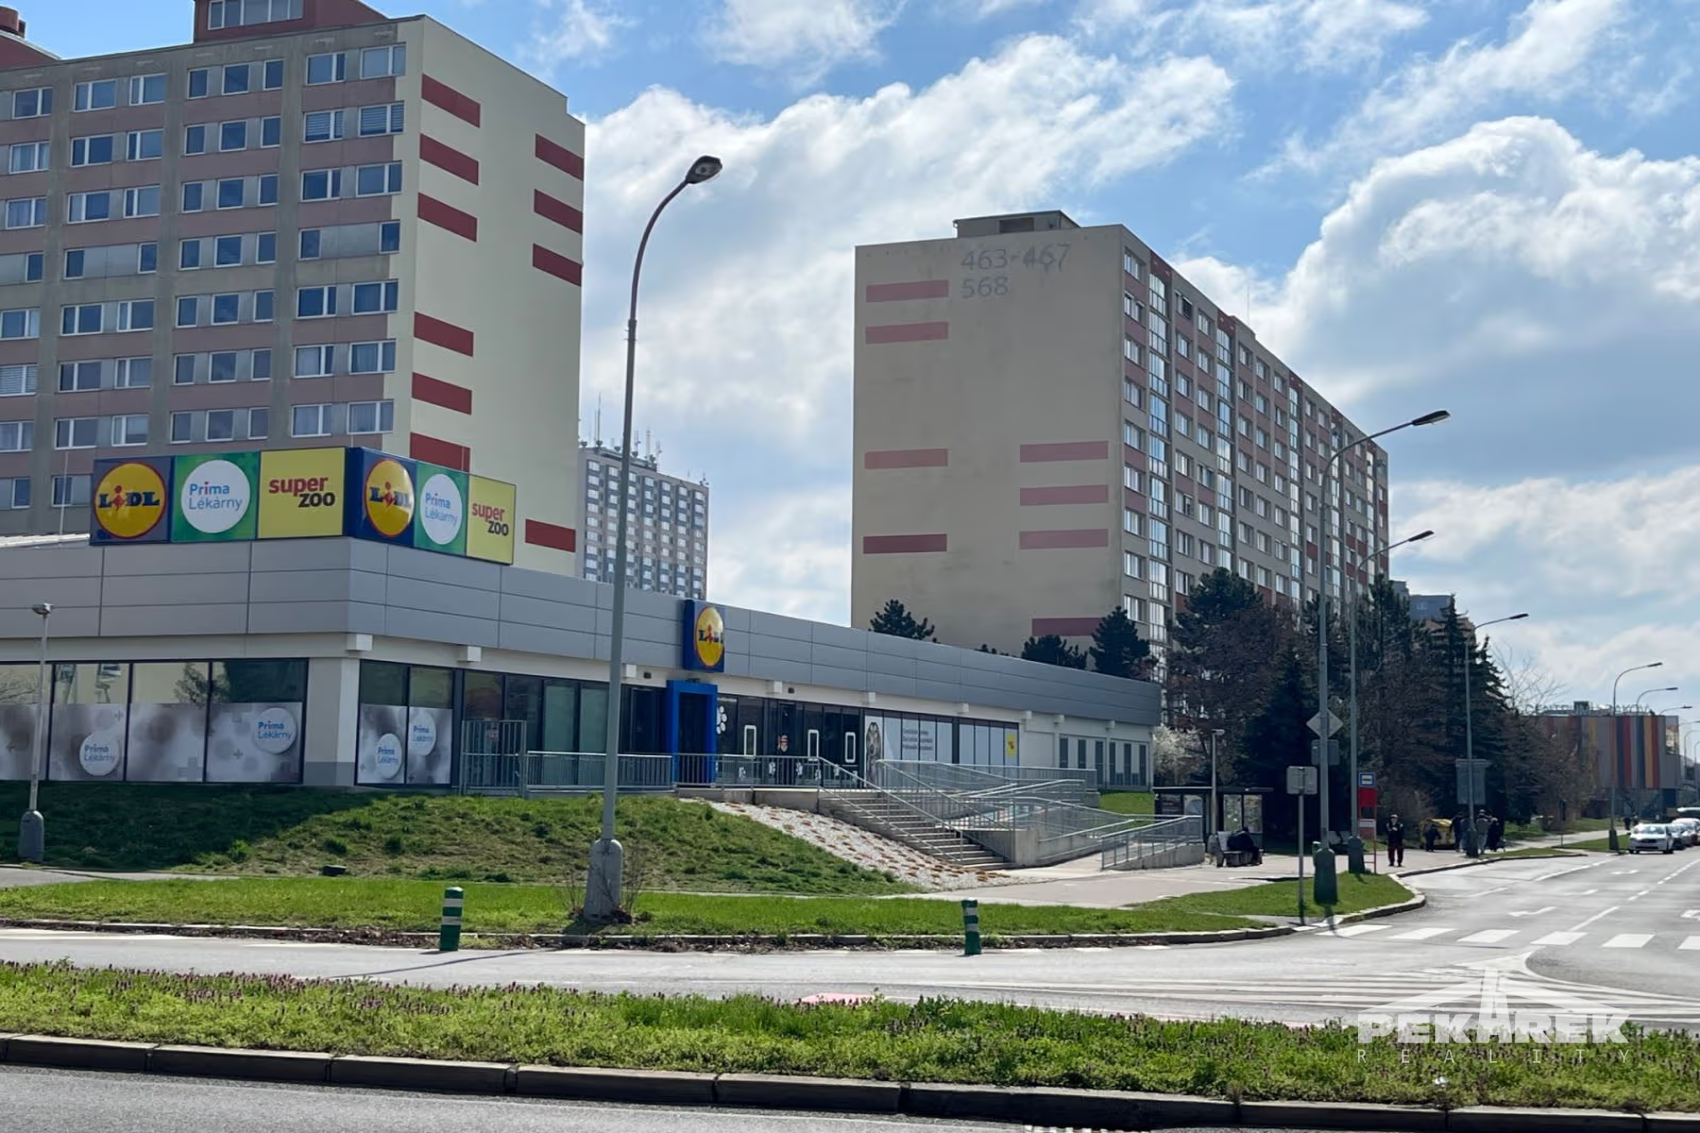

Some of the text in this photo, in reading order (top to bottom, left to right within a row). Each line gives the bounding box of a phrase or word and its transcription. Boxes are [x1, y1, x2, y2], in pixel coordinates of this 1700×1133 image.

[961, 276, 1009, 299] 568
[189, 481, 230, 496] Prima
[268, 477, 328, 497] super
[188, 494, 243, 511] Lékárny
[425, 492, 451, 509] Prima
[472, 503, 505, 523] super
[257, 720, 284, 731] Prima
[84, 744, 109, 753] Prima
